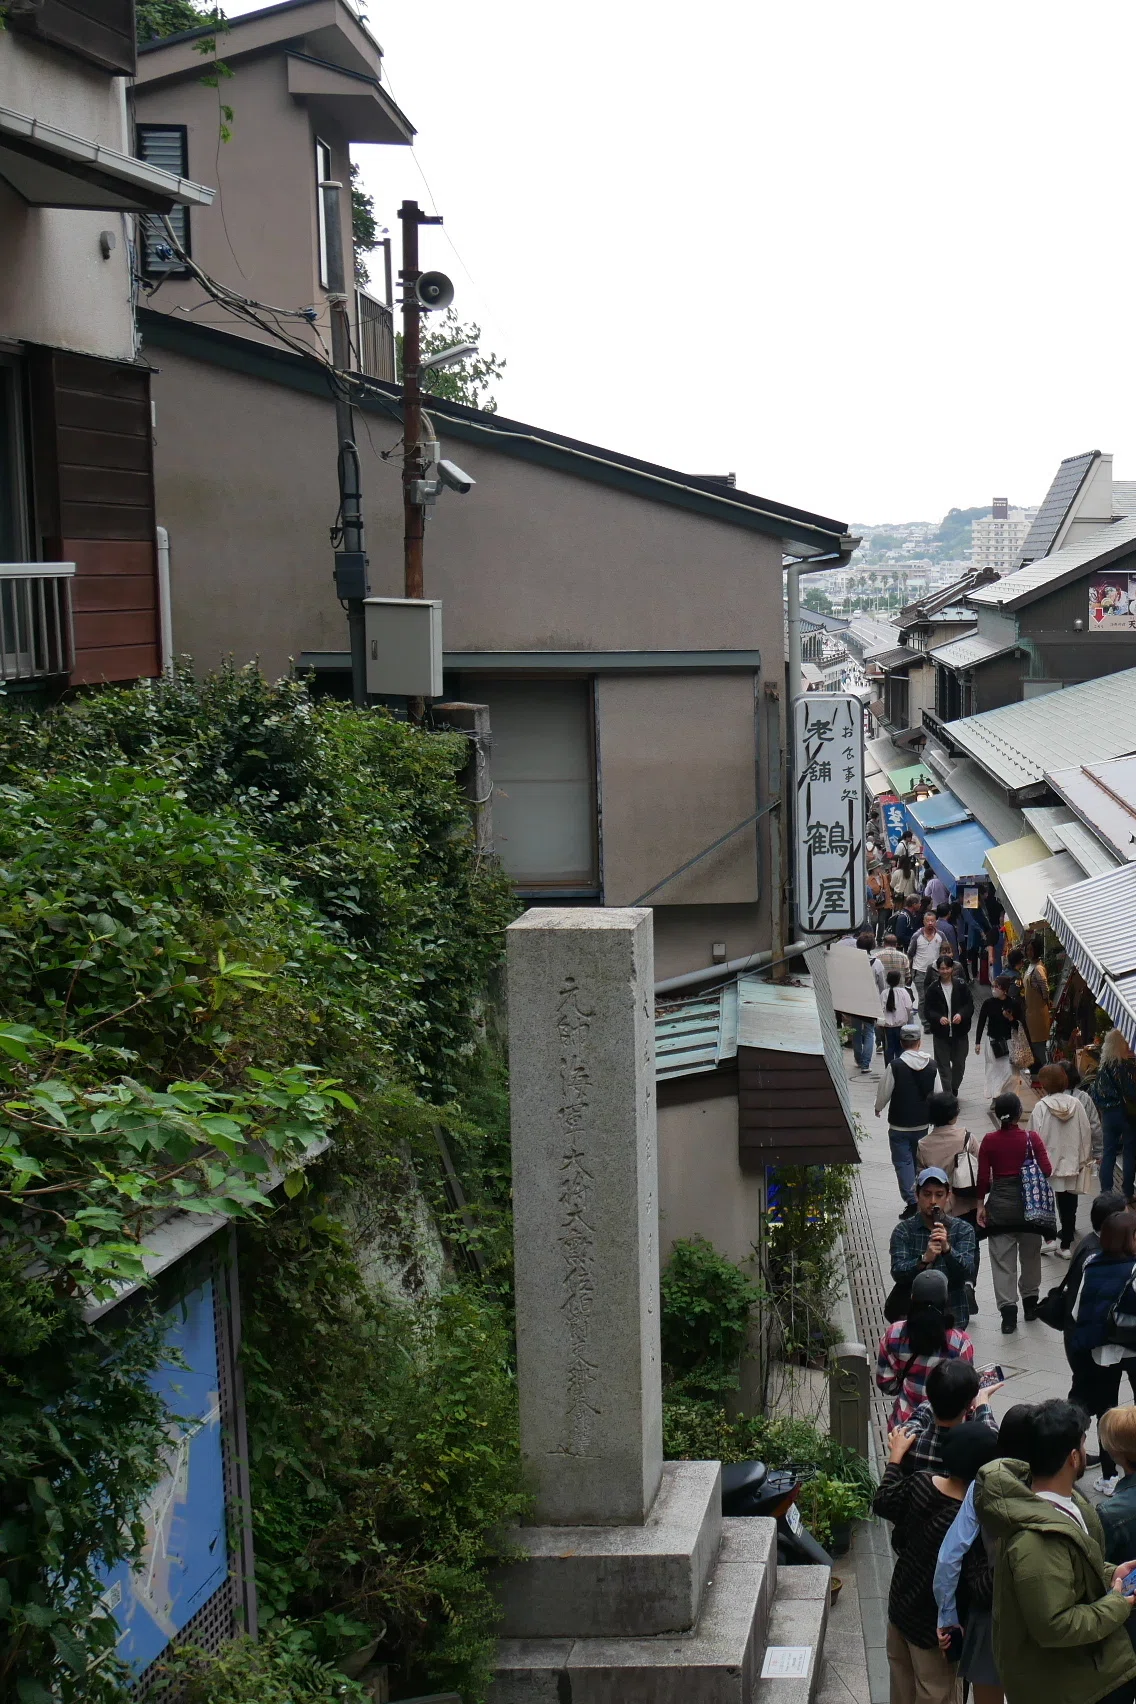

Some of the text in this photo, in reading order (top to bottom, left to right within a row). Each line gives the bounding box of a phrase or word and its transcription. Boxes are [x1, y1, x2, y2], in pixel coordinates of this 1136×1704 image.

[803, 719, 851, 918] 老舗 鶴屋
[841, 725, 859, 802] お食事処
